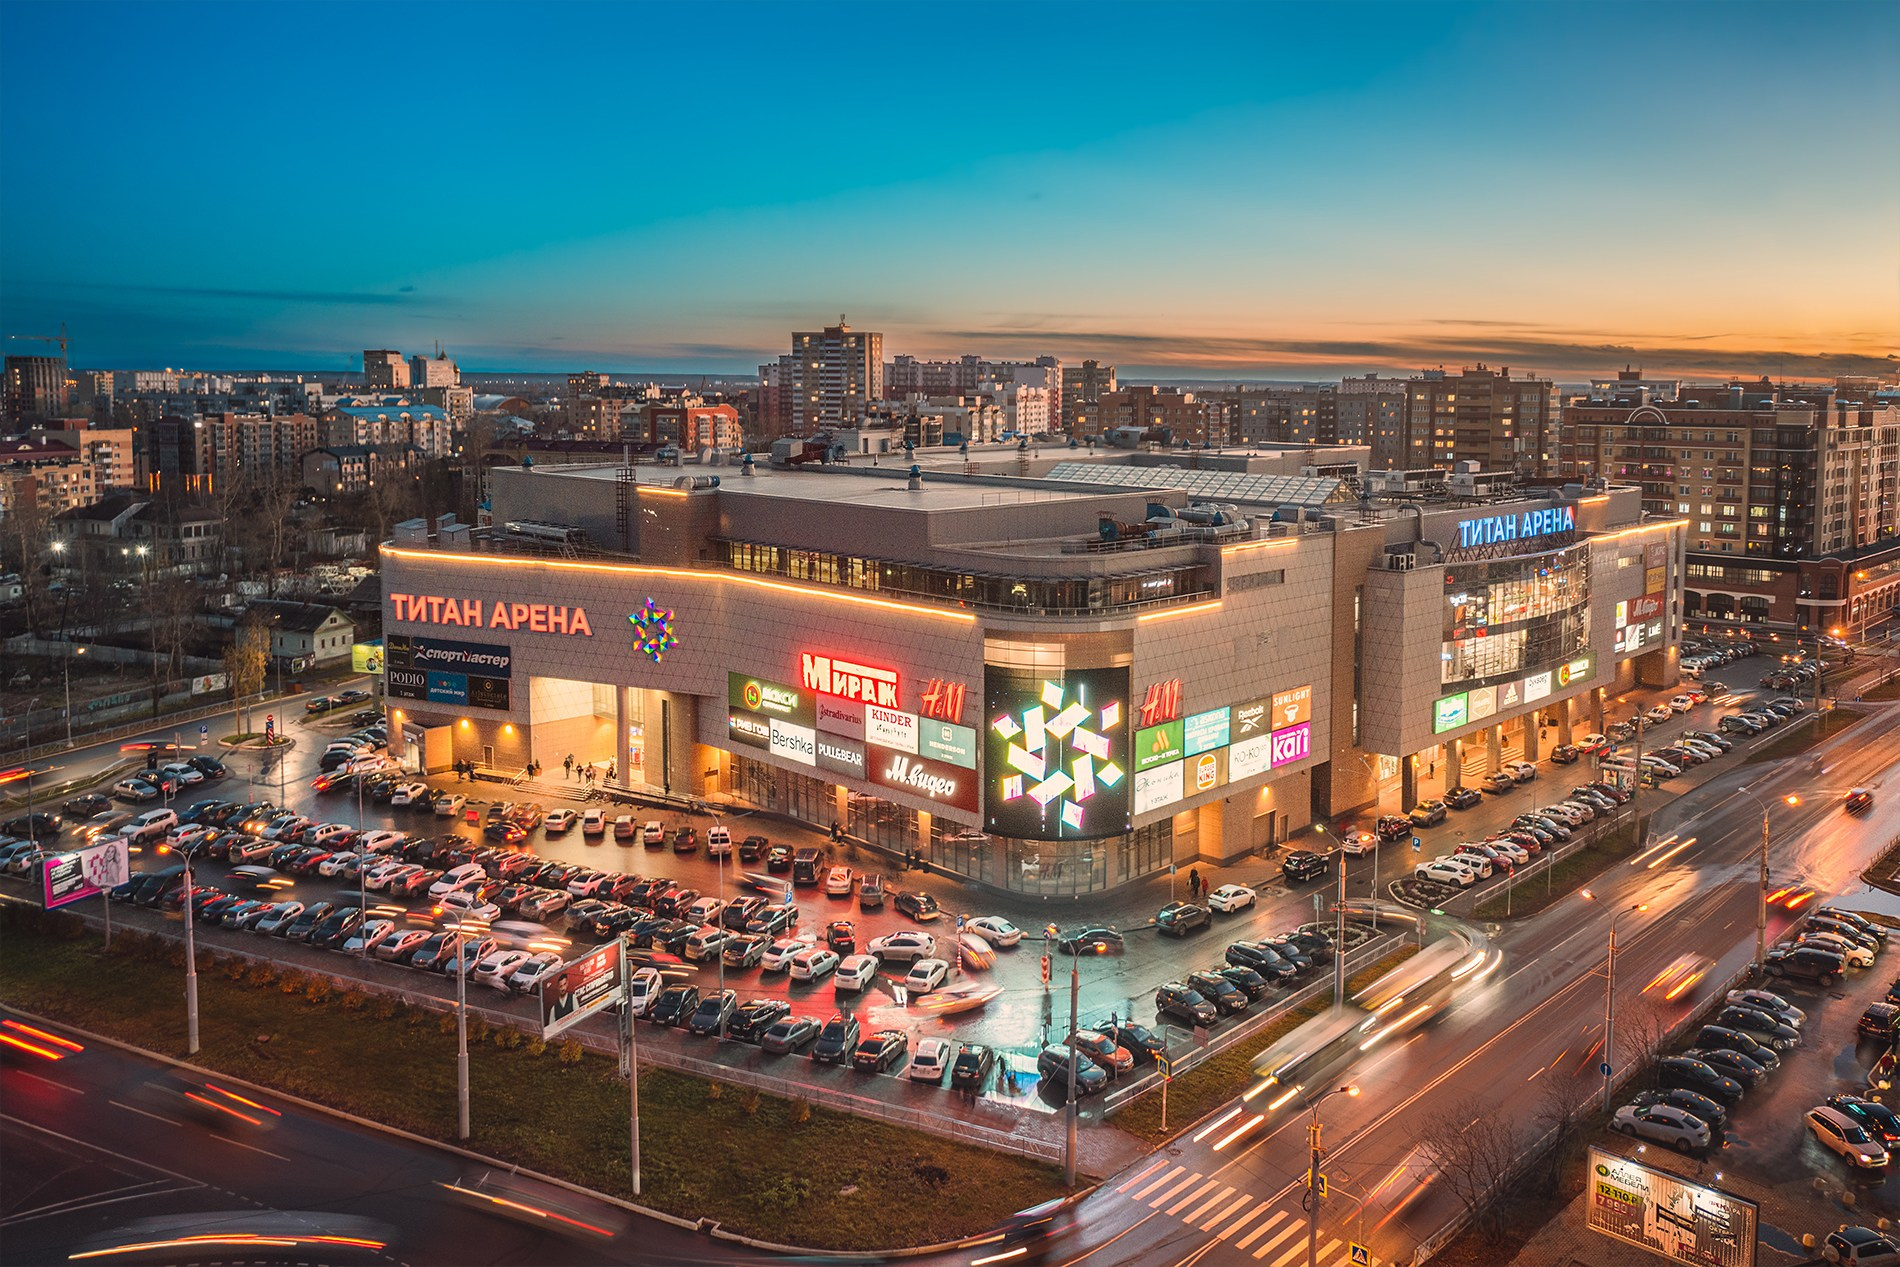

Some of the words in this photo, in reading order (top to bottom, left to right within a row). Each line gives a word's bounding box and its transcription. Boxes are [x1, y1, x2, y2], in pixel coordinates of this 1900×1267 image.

[1458, 514, 1517, 548] ТИТАН
[1521, 505, 1575, 538] АРЕНА
[389, 593, 483, 628] ТИТАН
[489, 601, 593, 637] АРЕНА
[390, 671, 425, 686] PODIO
[430, 687, 453, 696] детский
[921, 677, 966, 724] H&M
[1274, 689, 1310, 706] SUNLIGHT
[1140, 678, 1181, 727] H&M
[872, 709, 912, 728] KINDER
[1238, 705, 1264, 720] Reebok
[772, 729, 813, 755] Bershka
[929, 741, 966, 755] HENDERSON
[1273, 728, 1309, 762] kari
[818, 743, 863, 767] PULL&BEAR
[1199, 770, 1215, 782] KING
[1610, 1174, 1650, 1193] МЕБЕЛИ
